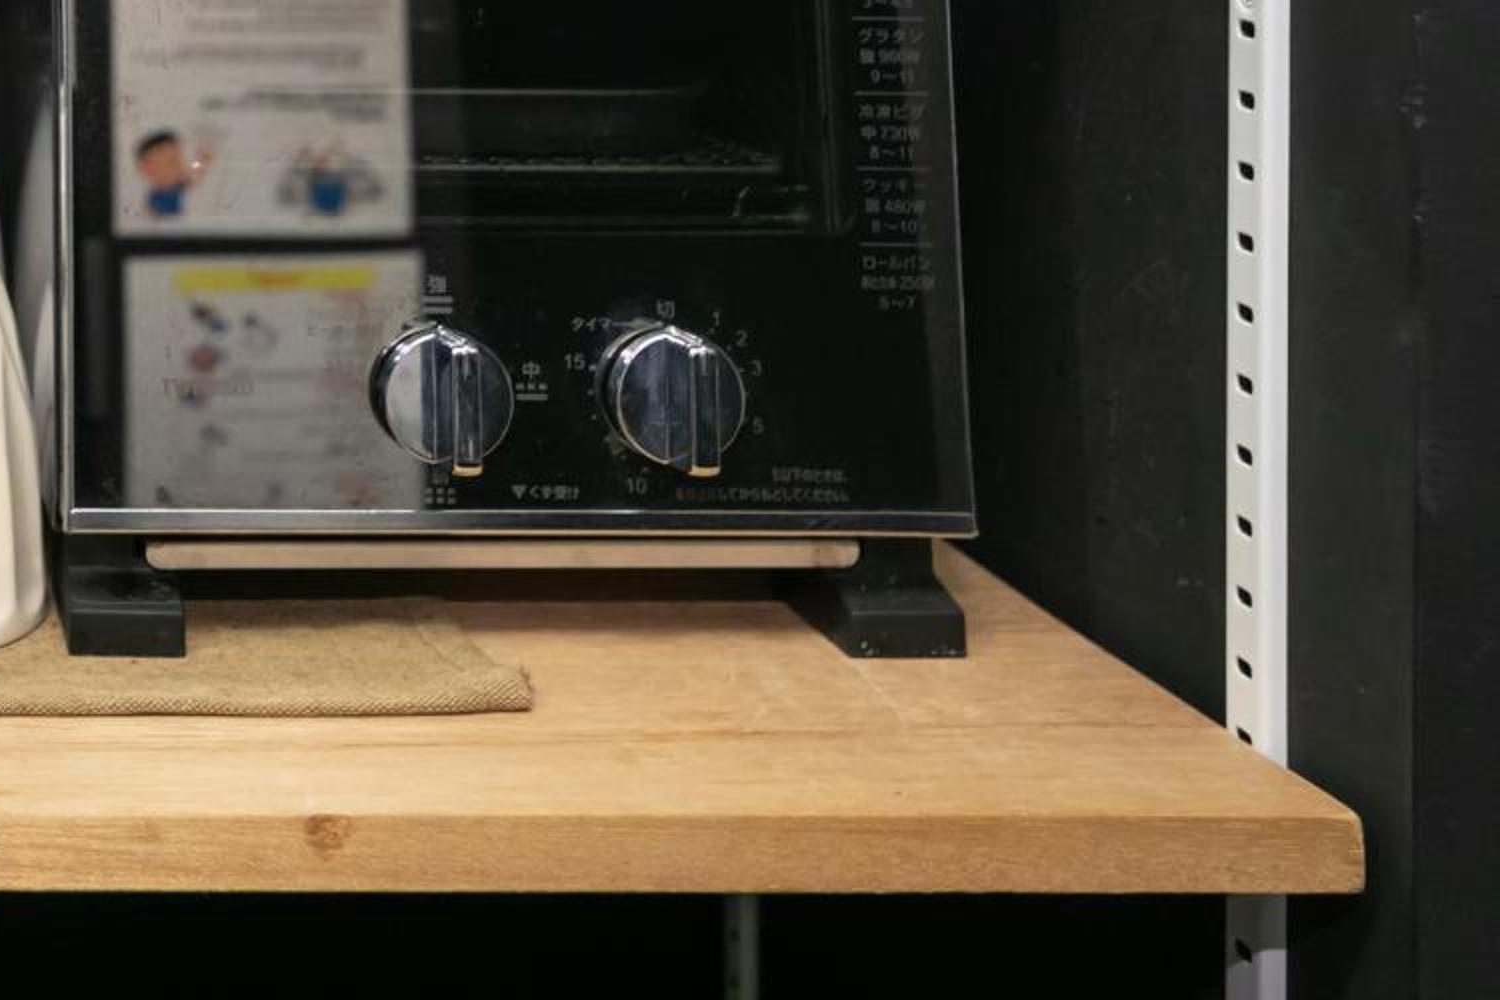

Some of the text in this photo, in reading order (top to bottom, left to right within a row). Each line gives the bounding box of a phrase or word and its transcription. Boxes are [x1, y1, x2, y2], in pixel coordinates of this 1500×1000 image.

[857, 27, 924, 44] グラタン
[860, 125, 877, 142] 中
[862, 254, 932, 272] ロールパン
[655, 298, 676, 320] 切
[711, 310, 722, 327] 1
[736, 329, 749, 346] 2
[521, 360, 542, 381] 中
[563, 353, 587, 371] 15
[751, 359, 763, 376] 3
[752, 416, 765, 434] 5
[626, 477, 649, 495] 10
